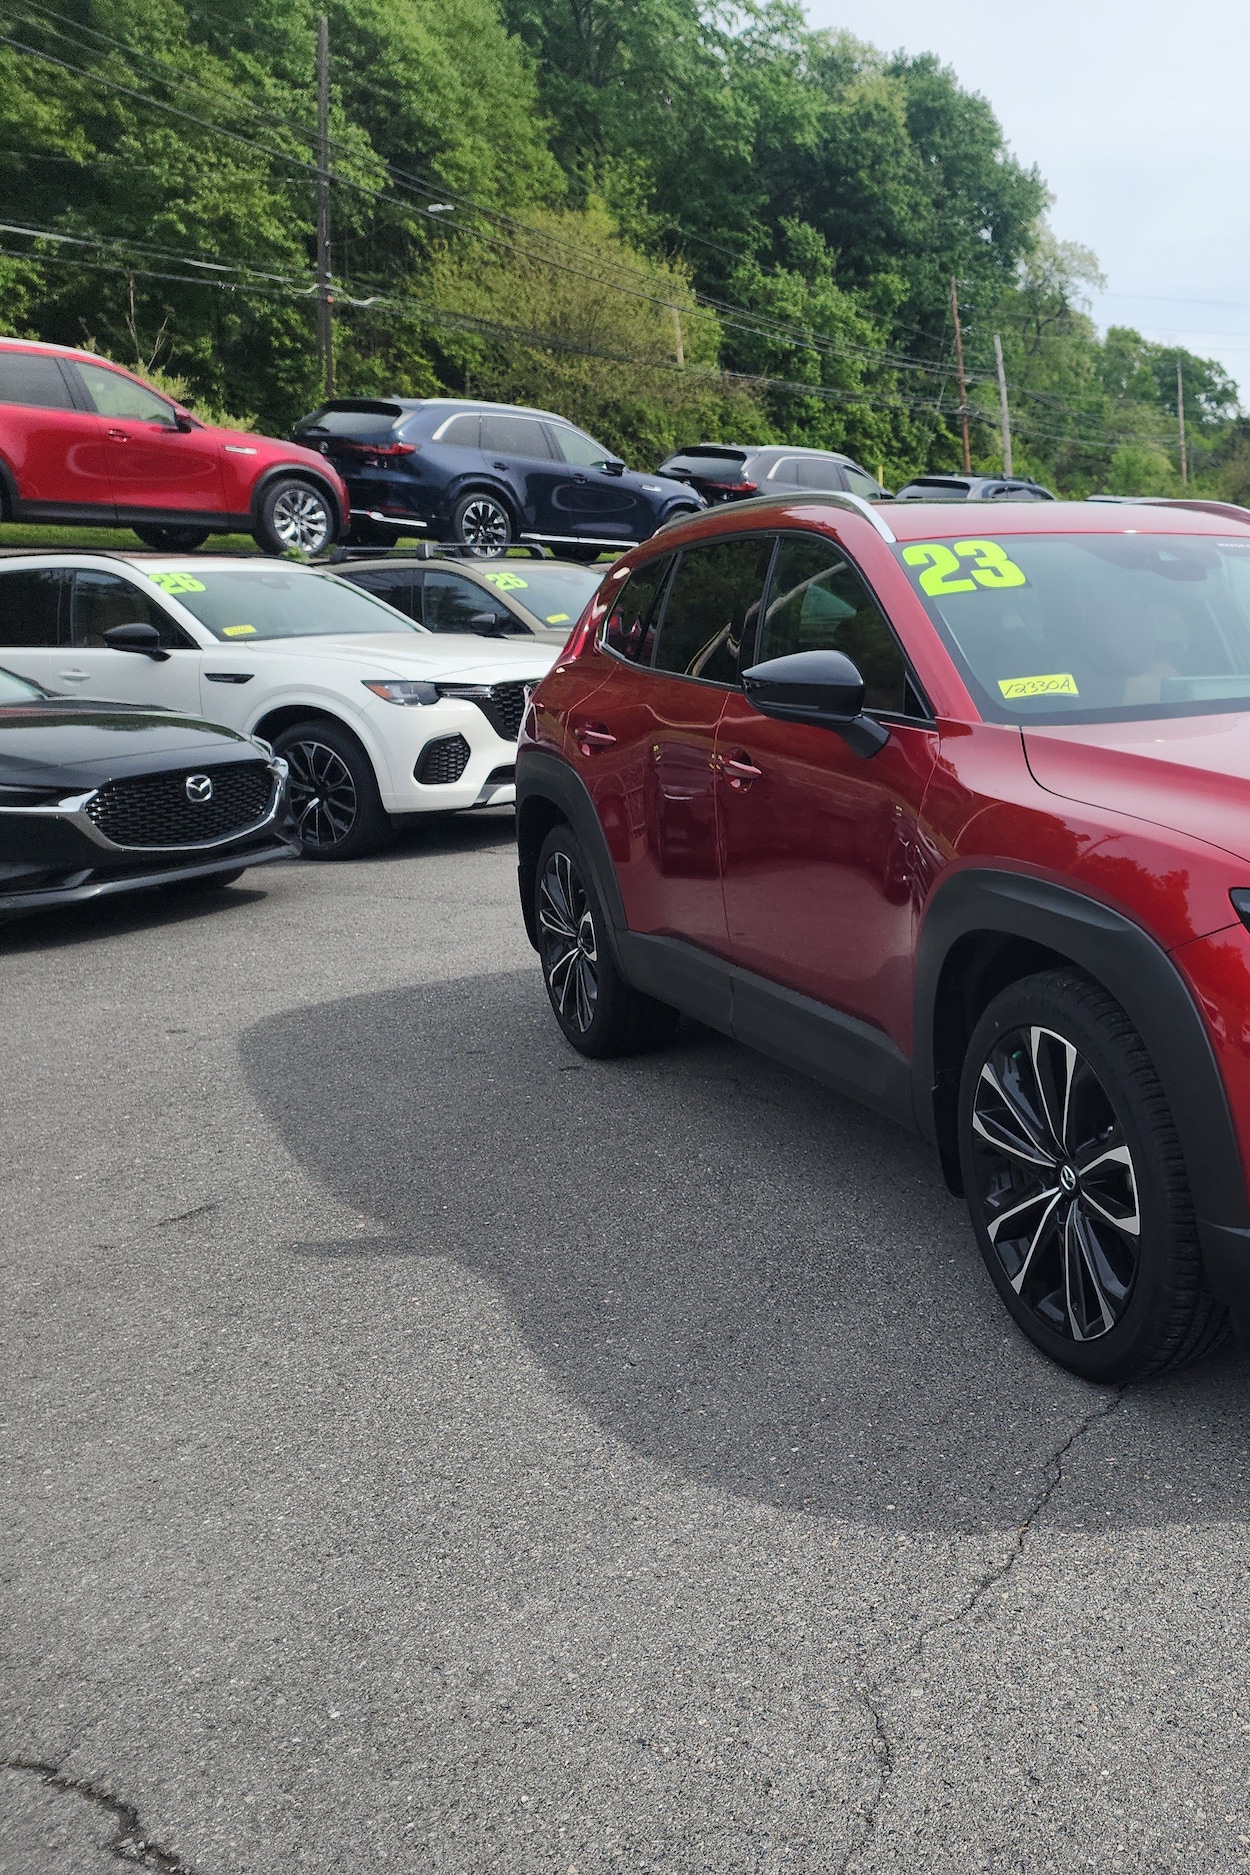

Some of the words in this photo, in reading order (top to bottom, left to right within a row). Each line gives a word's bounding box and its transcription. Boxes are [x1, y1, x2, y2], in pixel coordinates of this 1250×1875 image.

[902, 540, 1026, 596] 23
[148, 572, 206, 595] 26
[485, 572, 529, 591] 26
